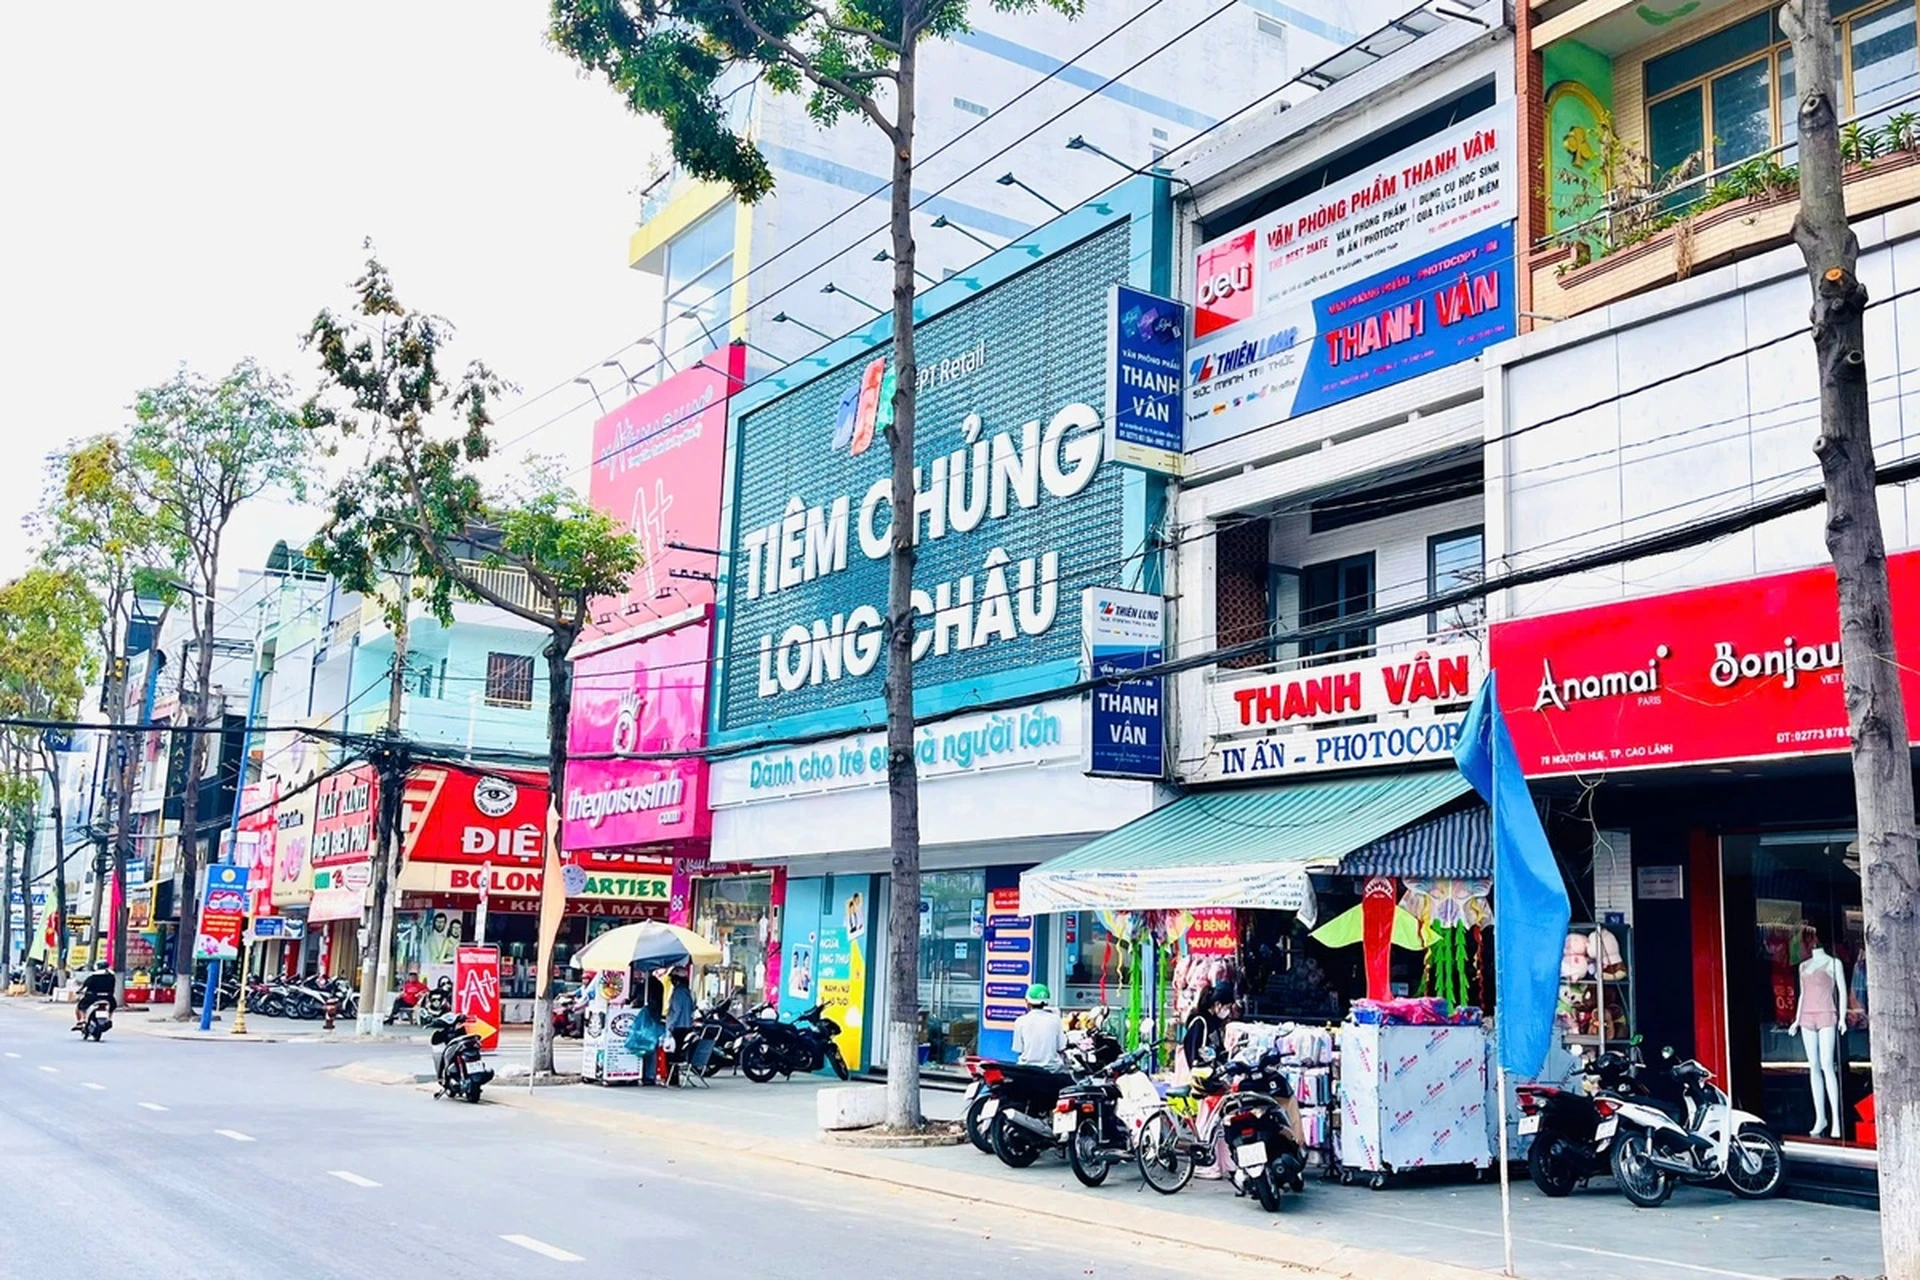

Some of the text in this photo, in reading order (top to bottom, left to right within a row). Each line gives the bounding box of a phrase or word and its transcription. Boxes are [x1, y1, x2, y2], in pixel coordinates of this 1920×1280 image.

[1267, 129, 1496, 248] VĂN PHÒNG PHẨM THANH VÂN
[1417, 248, 1478, 280] PHOTOCOPY
[1198, 262, 1253, 306] deli
[1325, 271, 1499, 366] THANH VÂN
[940, 344, 985, 382] Retail
[1217, 339, 1258, 376] THIÊN
[1122, 364, 1180, 396] THANH
[1133, 395, 1169, 424] VÂN
[744, 496, 850, 601] TIÊM
[857, 402, 1106, 560] CHỦNG
[758, 547, 1060, 699] LONG CHÂU
[1234, 651, 1469, 726] THANH VÂN
[1533, 657, 1658, 712] Anamai
[1637, 695, 1662, 706] PARIS
[1098, 692, 1159, 717] THANH
[751, 755, 795, 791] Dành
[801, 747, 833, 782] cho
[838, 735, 866, 776] trẻ
[942, 714, 1014, 770] người
[1019, 710, 1060, 748] lớn
[1109, 721, 1147, 746] VÂN
[1610, 749, 1624, 760] TP.
[1625, 746, 1646, 758] CAO
[1222, 747, 1246, 775] IN
[1251, 738, 1286, 770] ẤN
[567, 771, 683, 828] thegioisosinh
[461, 823, 546, 863] ĐIỆ
[1203, 916, 1232, 934] BỆNH
[458, 968, 497, 1015] A+
